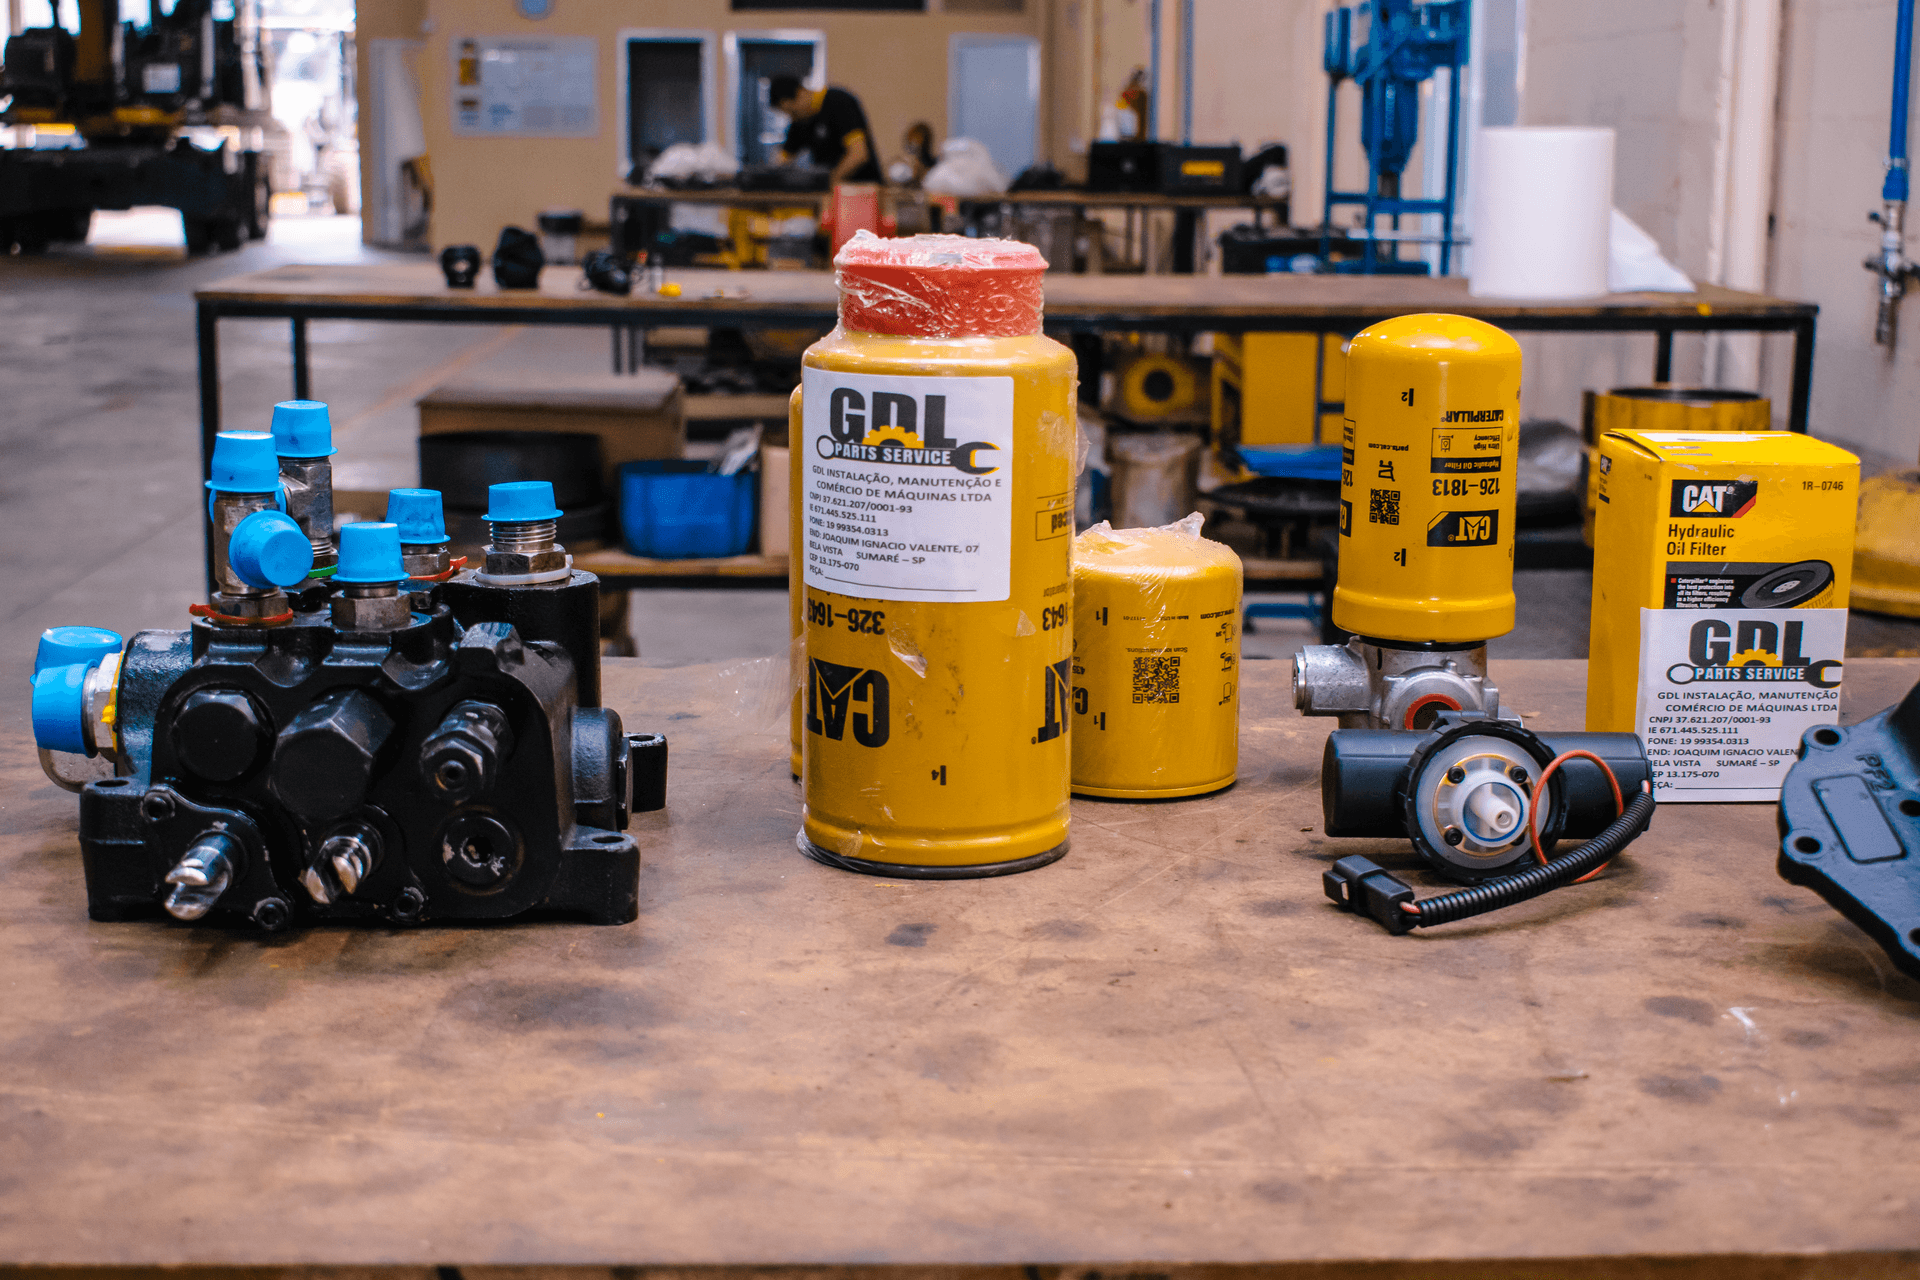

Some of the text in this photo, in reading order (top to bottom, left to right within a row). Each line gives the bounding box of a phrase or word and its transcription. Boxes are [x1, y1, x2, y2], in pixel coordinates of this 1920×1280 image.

[830, 387, 957, 449] GDL
[835, 442, 951, 465] PARTS SERVICE
[1368, 442, 1409, 451] parts.cat.com
[1473, 443, 1486, 451] High
[1473, 460, 1499, 468] Hydraulic
[812, 464, 1002, 489] GDL INSTALAÇÃO, MANUTENÇÃO E
[816, 480, 992, 502] COMÉRCIO DE MÁQUINAS LTDA
[1432, 477, 1500, 496] 126-1813
[1801, 481, 1844, 491] 1R-0746
[809, 491, 913, 513] CNPJ 37.621.207/0001-93
[809, 503, 876, 523] IE 671.445.525.111
[809, 515, 889, 536] FONE: 19 99354.0313
[1668, 523, 1735, 541] Hydraulic
[809, 528, 979, 553] END: JOAQUIM IGNACIO VALENTE, 07
[809, 540, 843, 556] BELA VISTA
[1667, 541, 1726, 556] Oil Filter
[809, 552, 859, 571] CEP 13.175-070
[856, 552, 899, 563] SUMARÉ
[912, 556, 925, 564] SP
[809, 564, 823, 575] PEÇA:
[807, 597, 885, 635] 326-1643
[1689, 619, 1811, 667] GDL
[1695, 667, 1805, 680] PARTS SERVICE
[1657, 690, 1838, 701] GDL INSTALAÇÃO, MANUTENÇÃO
[1665, 703, 1838, 713] COMÉRCIO DE MÁQUINAS LTDA
[1649, 716, 1771, 725] CNPJ 37.621.207/0001-93
[1647, 748, 1799, 757] END: JOAQUIM IGNACIO VALEN
[1673, 759, 1701, 767] VISTA
[1716, 758, 1758, 767] SUMARÉ
[1768, 759, 1780, 767] SP
[1652, 781, 1674, 790] EÇA:
